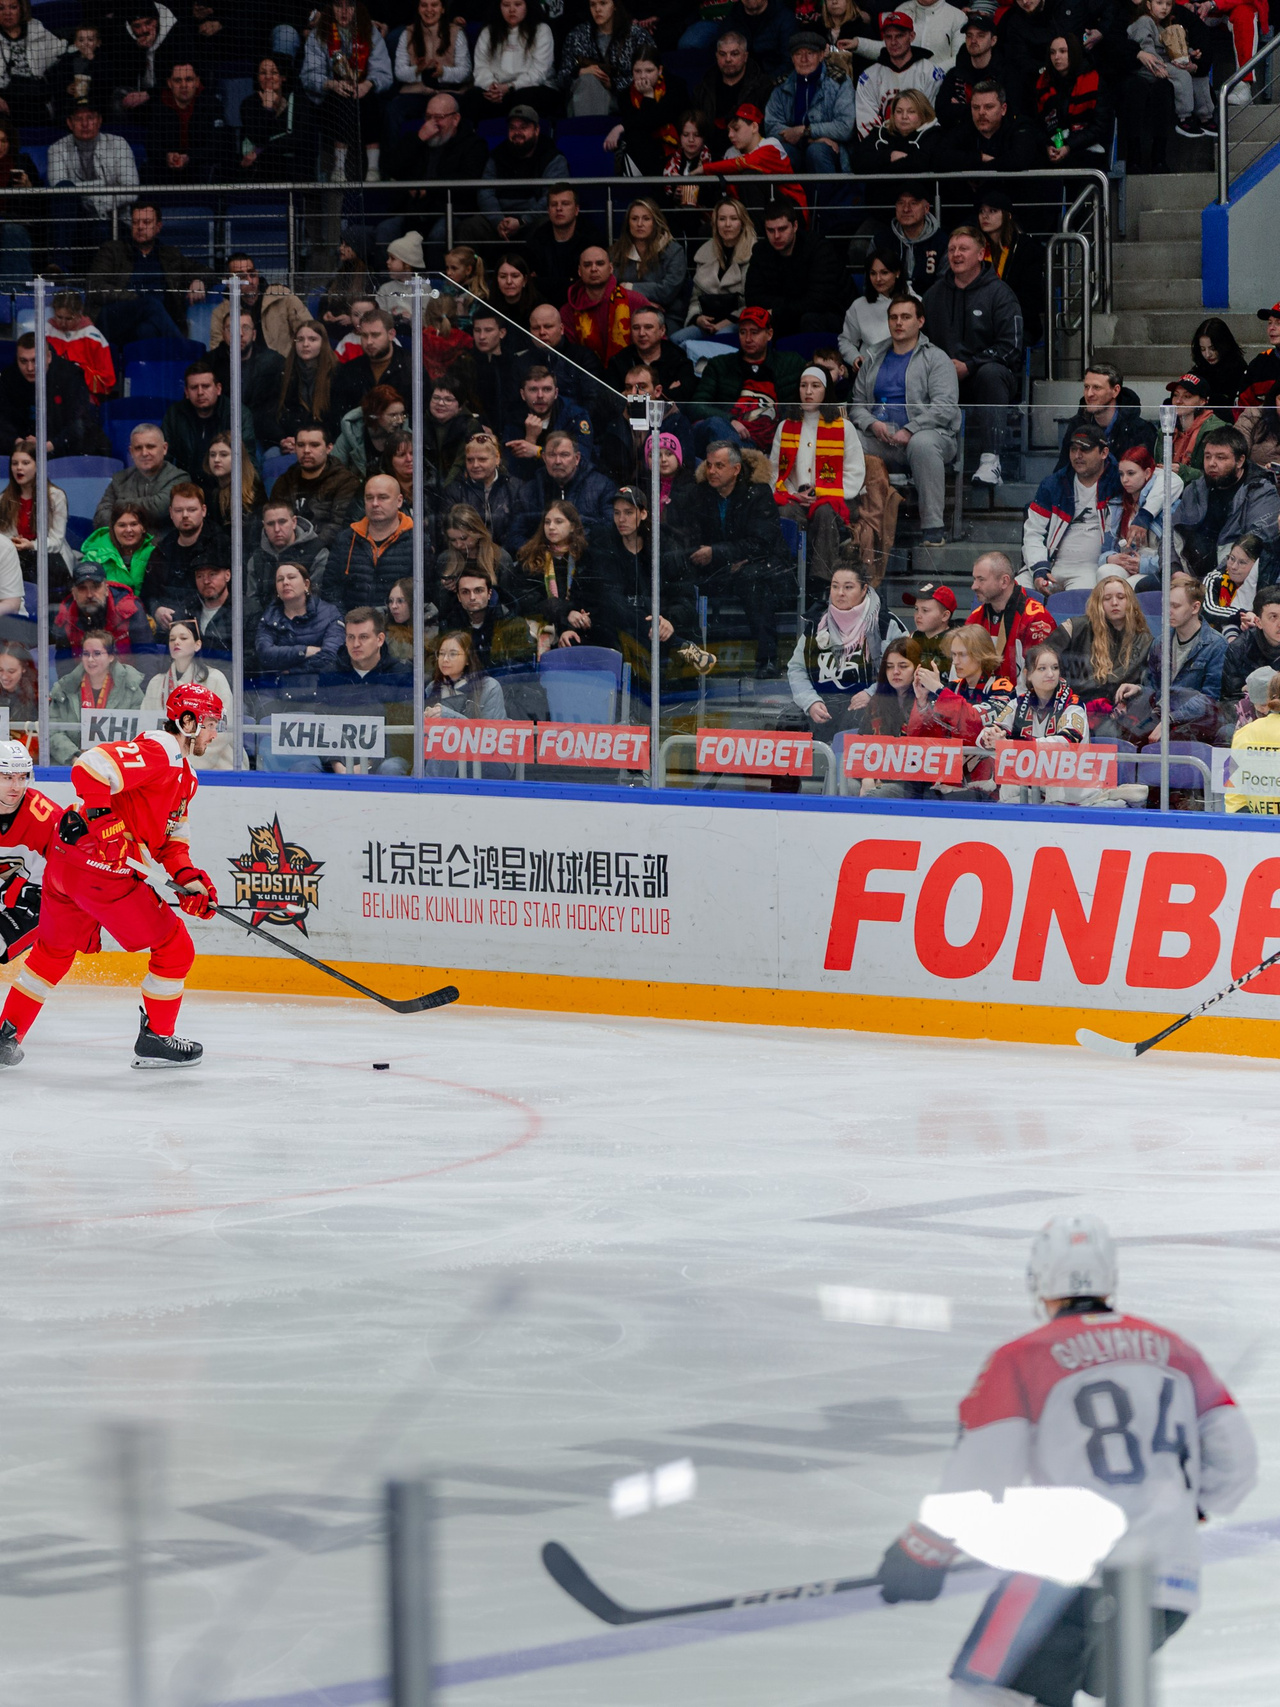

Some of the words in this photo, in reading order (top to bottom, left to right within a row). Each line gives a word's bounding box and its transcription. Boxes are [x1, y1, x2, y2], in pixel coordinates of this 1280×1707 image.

[278, 721, 378, 750] KHL.RU
[426, 724, 533, 757] FONBET
[539, 730, 649, 763] FONBET
[698, 736, 812, 769] FONBET
[115, 742, 147, 769] 27
[846, 741, 963, 776] FONBET
[996, 747, 1118, 783] FONBET
[362, 840, 669, 898] 北京昆仑鸿星冰球俱乐部
[229, 871, 325, 909] REDSTAR
[362, 891, 420, 920] BEIJING
[425, 895, 484, 924] KUNLUN
[489, 899, 518, 926] RED
[523, 902, 561, 929] STAR
[567, 903, 626, 932] HOCKEY
[630, 907, 671, 935] CLUB
[1189, 963, 1263, 1020] SOYUZ
[1072, 1373, 1192, 1486] 84
